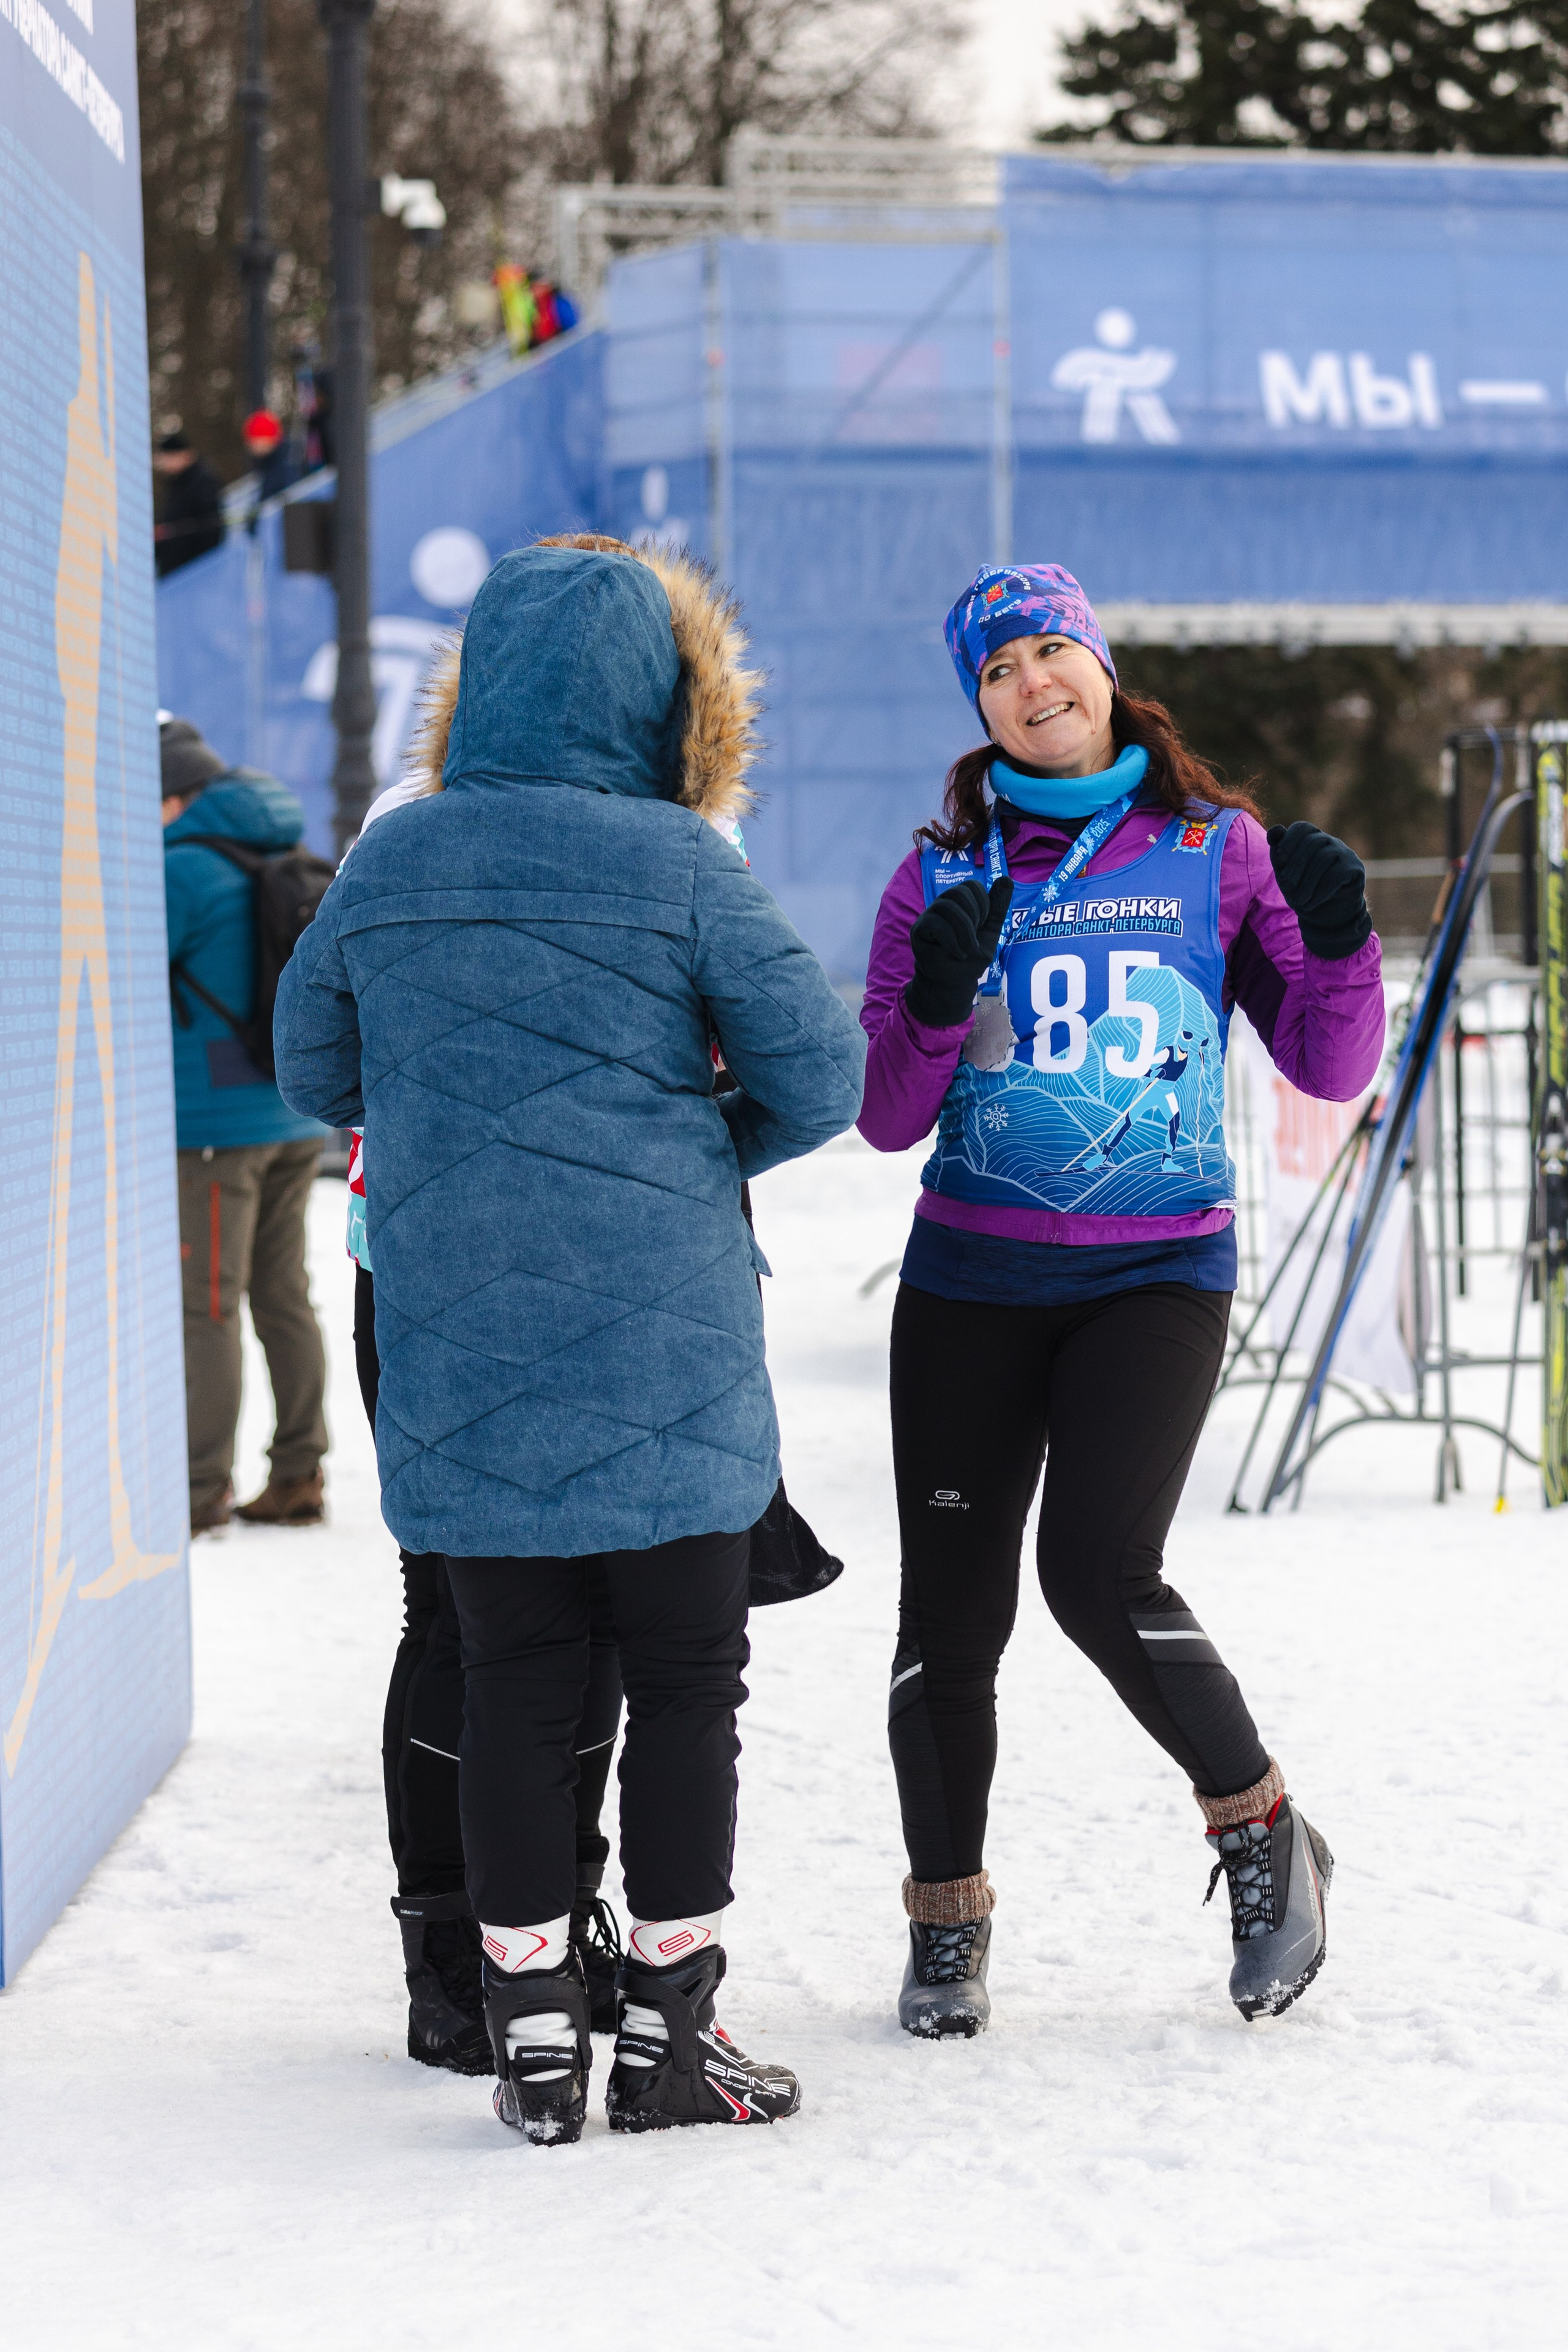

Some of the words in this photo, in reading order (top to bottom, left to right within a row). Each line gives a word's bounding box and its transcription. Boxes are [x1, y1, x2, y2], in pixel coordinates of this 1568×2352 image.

[1259, 350, 1441, 430] МЫ
[994, 598, 1022, 617] БЕГУ
[1058, 870, 1069, 882] 19
[1065, 845, 1088, 875] ЯНВАРЯ
[1091, 818, 1111, 838] 2025
[935, 870, 973, 879] СПОРТИВНЫЙ
[1086, 899, 1178, 920] ГОНКИ
[1075, 918, 1181, 935] САНКТ-ПЕТЕРБУРГА
[929, 1499, 970, 1510] Kalenji
[619, 2039, 665, 2054] SPINE
[704, 2059, 791, 2097] SPINE
[721, 2078, 753, 2091] CONCEPT
